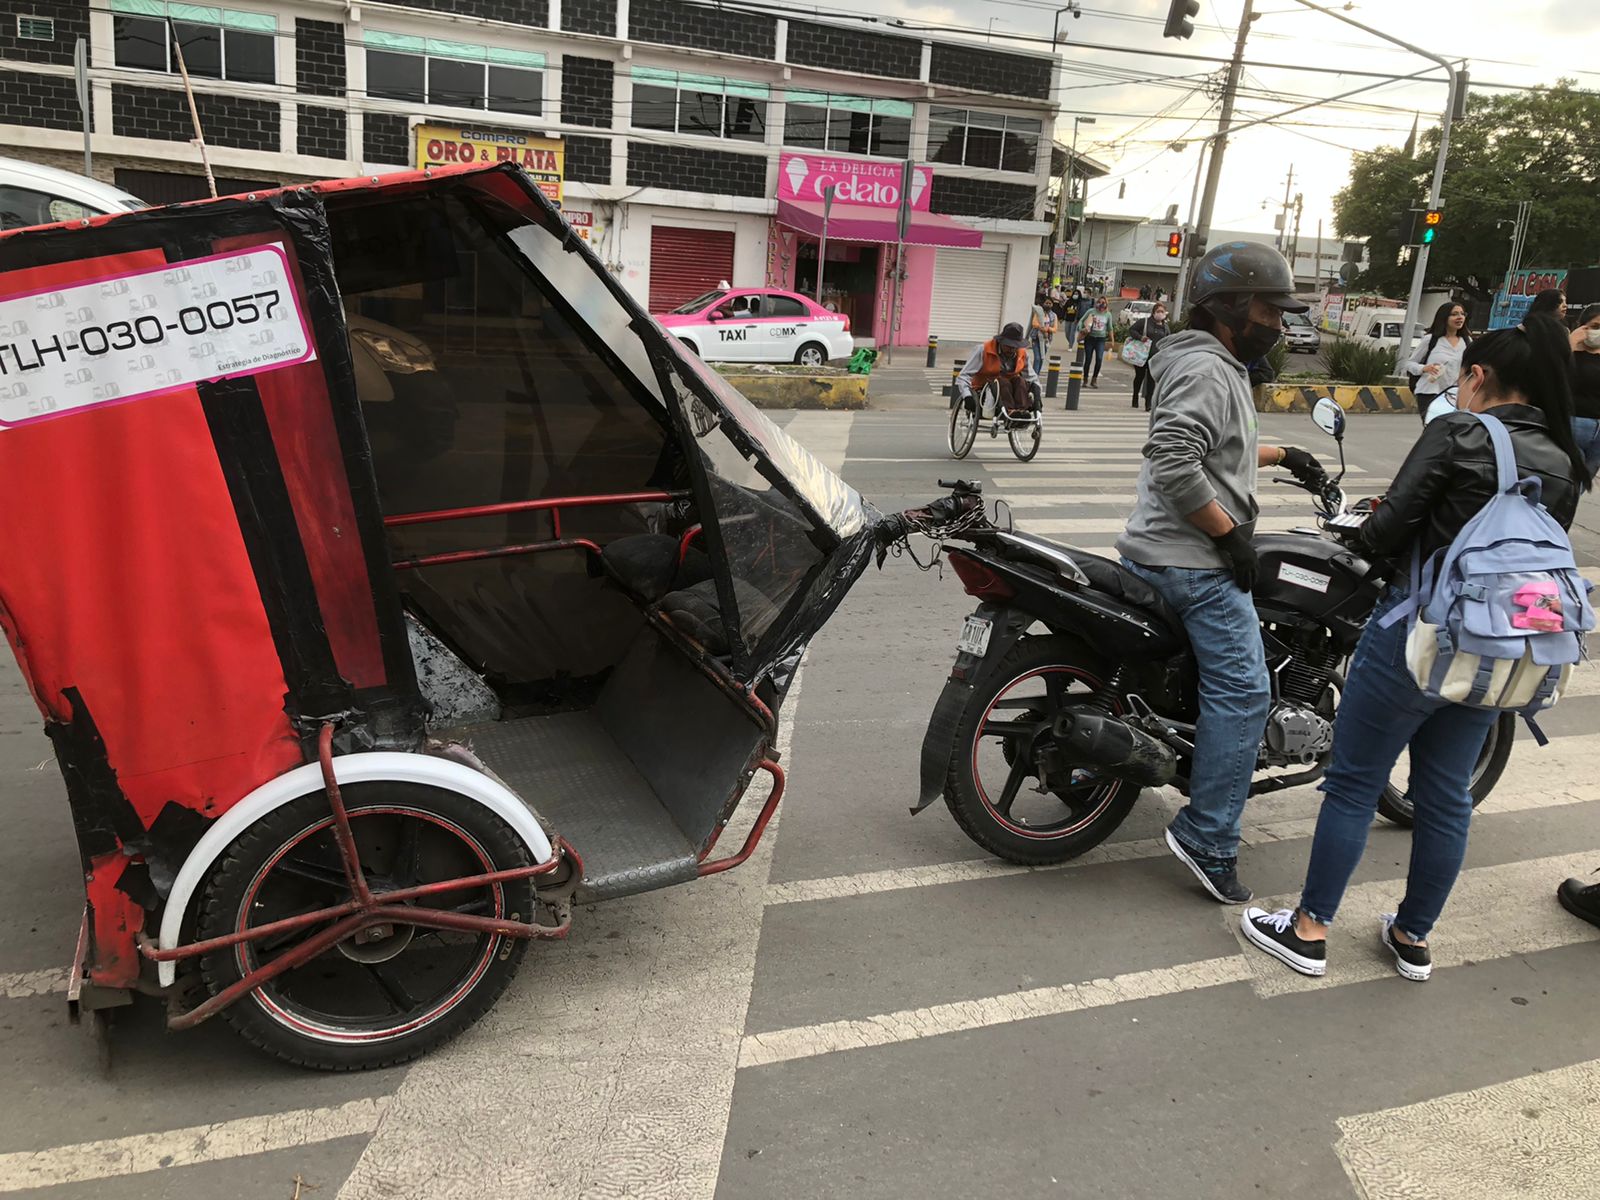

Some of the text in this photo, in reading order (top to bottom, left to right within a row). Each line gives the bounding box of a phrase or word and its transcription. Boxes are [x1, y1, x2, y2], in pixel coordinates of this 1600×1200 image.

[461, 130, 528, 145] COMPRO
[427, 139, 558, 171] ORO & PLATA
[820, 161, 896, 178] LA DELICIA
[1426, 212, 1440, 224] 53
[0, 289, 280, 375] TLH-030-0057
[718, 327, 797, 342] TAXI CDMX
[217, 358, 252, 371] Estrategia
[262, 347, 301, 361] Diagnóstico
